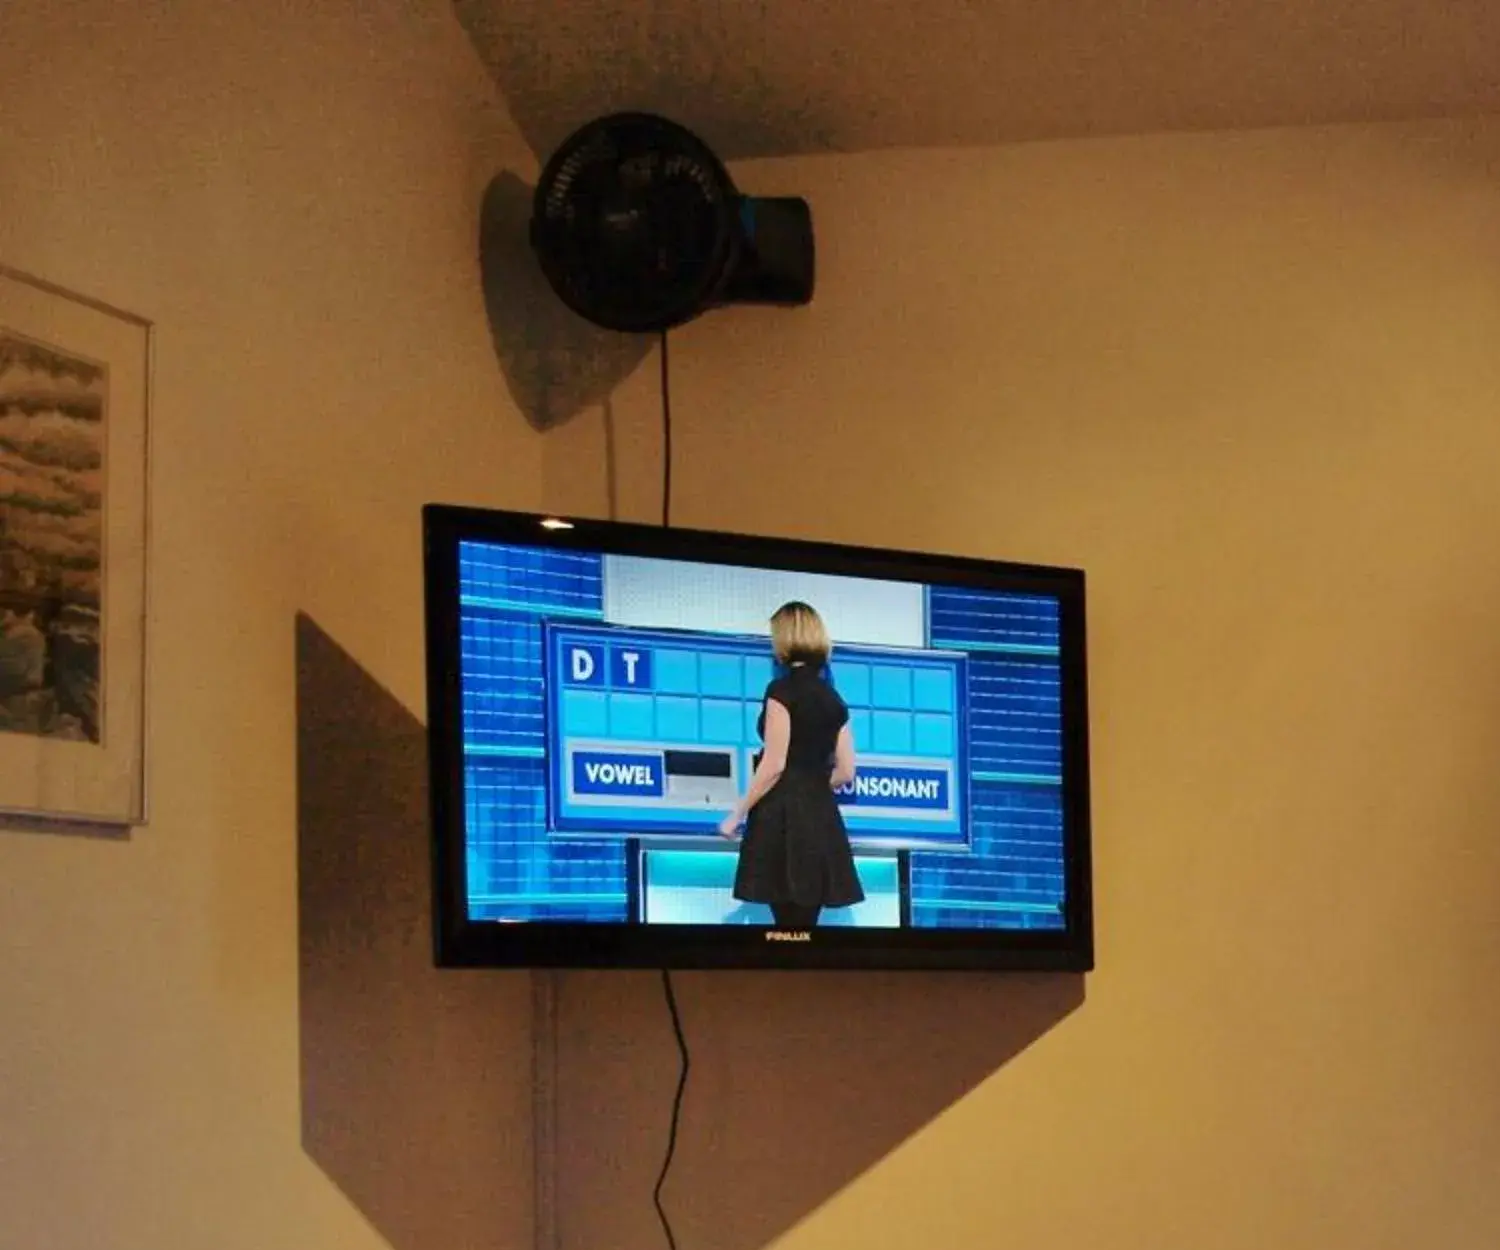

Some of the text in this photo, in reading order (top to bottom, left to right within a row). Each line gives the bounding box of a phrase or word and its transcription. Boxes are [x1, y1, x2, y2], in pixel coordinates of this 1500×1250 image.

[572, 648, 639, 685] D T
[584, 762, 655, 785] VOWEL
